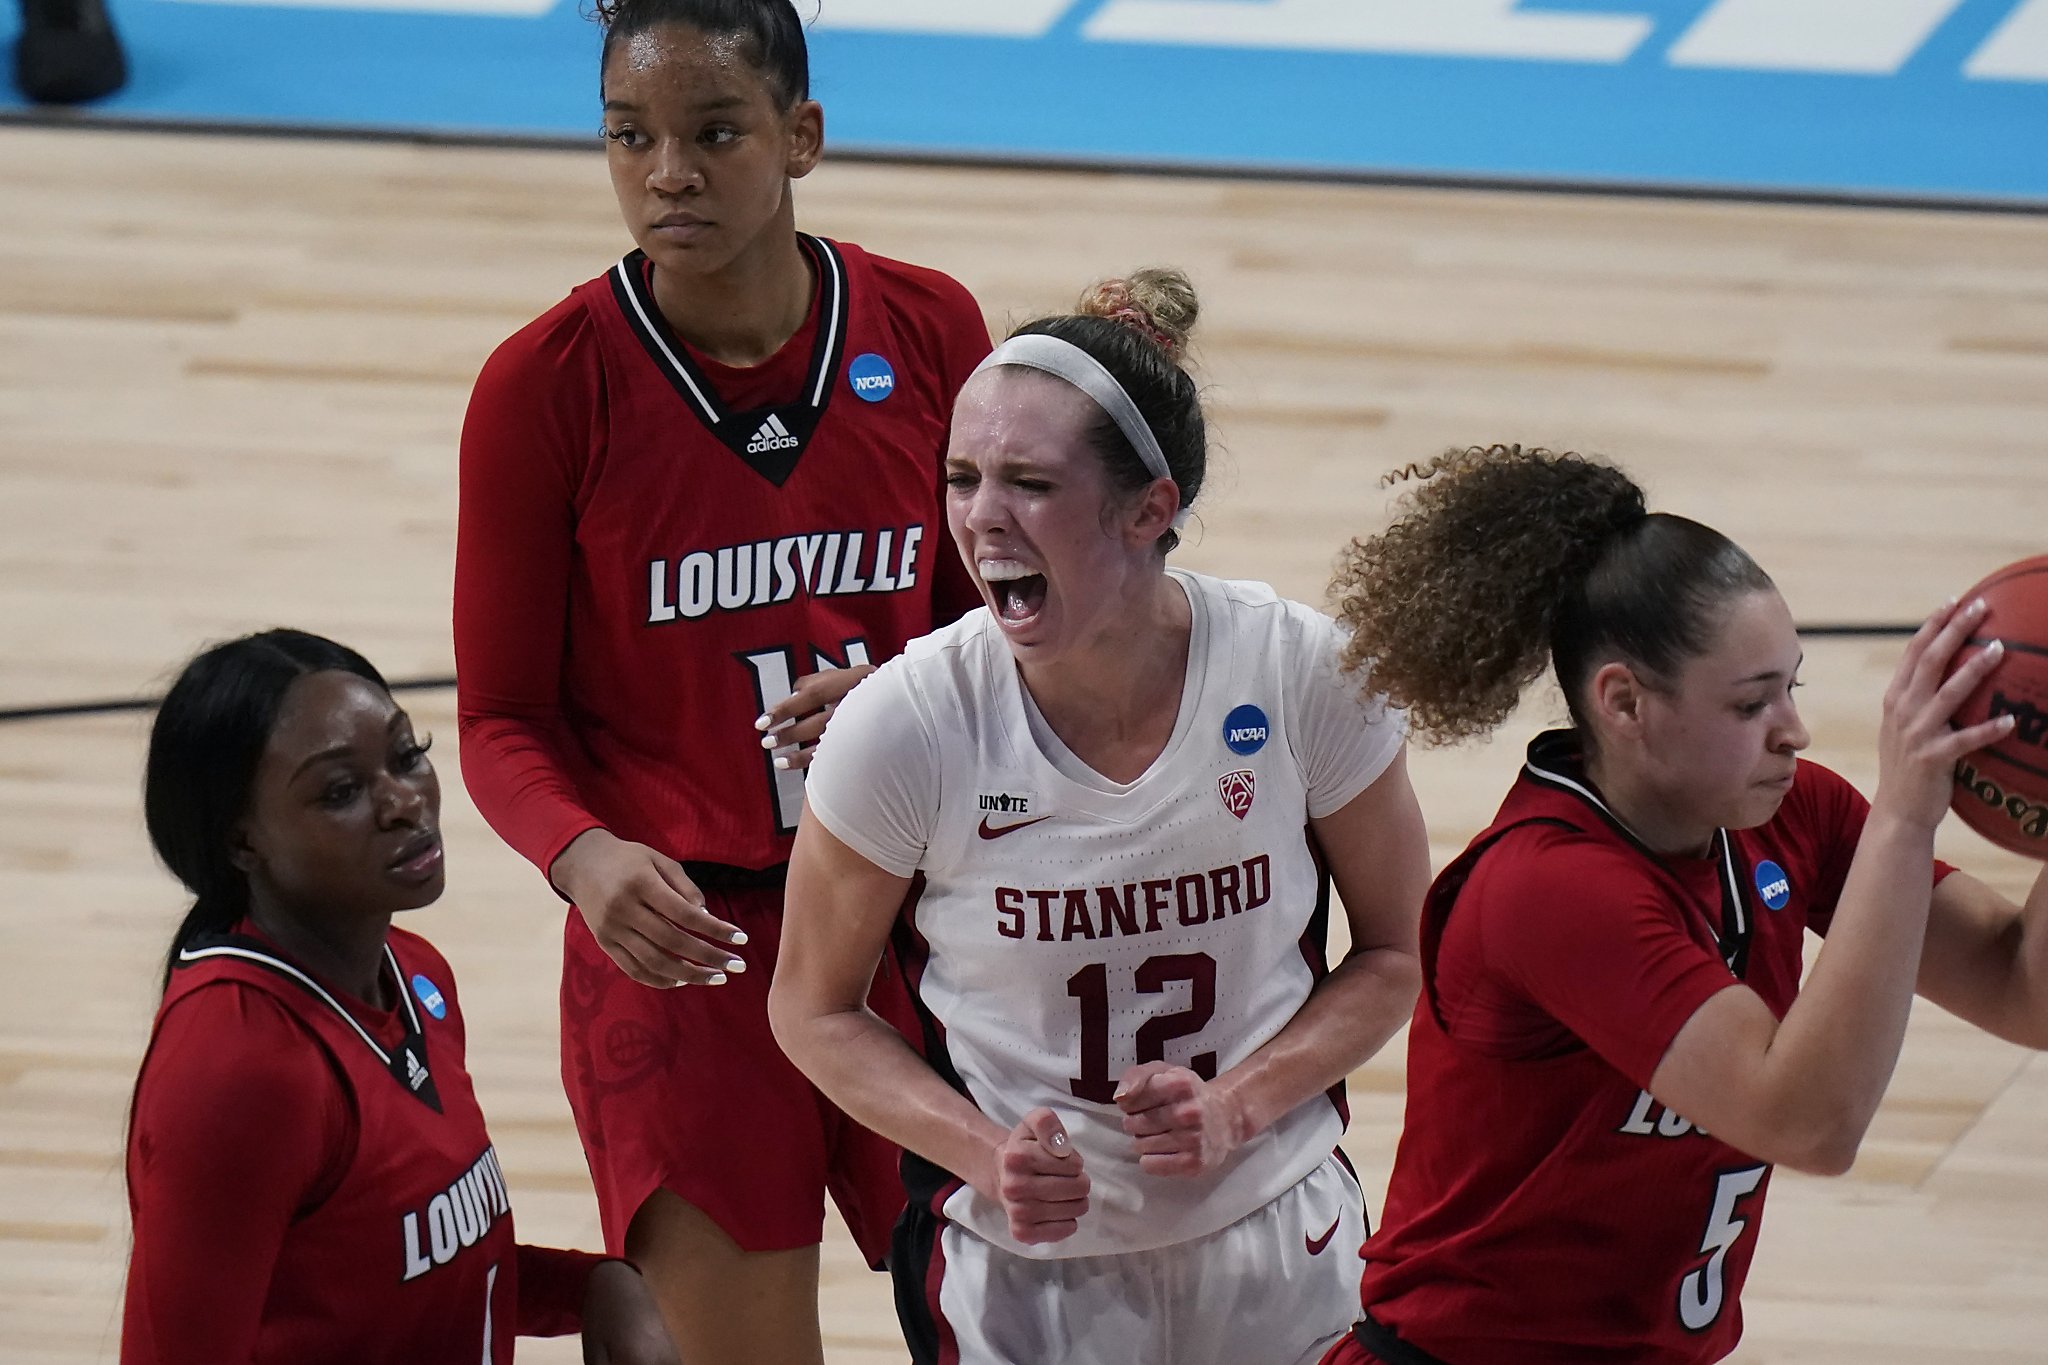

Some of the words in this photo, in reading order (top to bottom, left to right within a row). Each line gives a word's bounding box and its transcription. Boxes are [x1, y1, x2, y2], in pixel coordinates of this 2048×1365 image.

[855, 374, 893, 391] NCAA
[746, 434, 799, 453] adidas
[648, 525, 924, 622] LOUISVILLE
[1229, 726, 1266, 742] NCAA
[1219, 772, 1255, 803] PAC
[1230, 791, 1249, 812] 12
[994, 853, 1271, 942] STANFORD
[1066, 951, 1217, 1104] 12
[1678, 1164, 1768, 1330] 5
